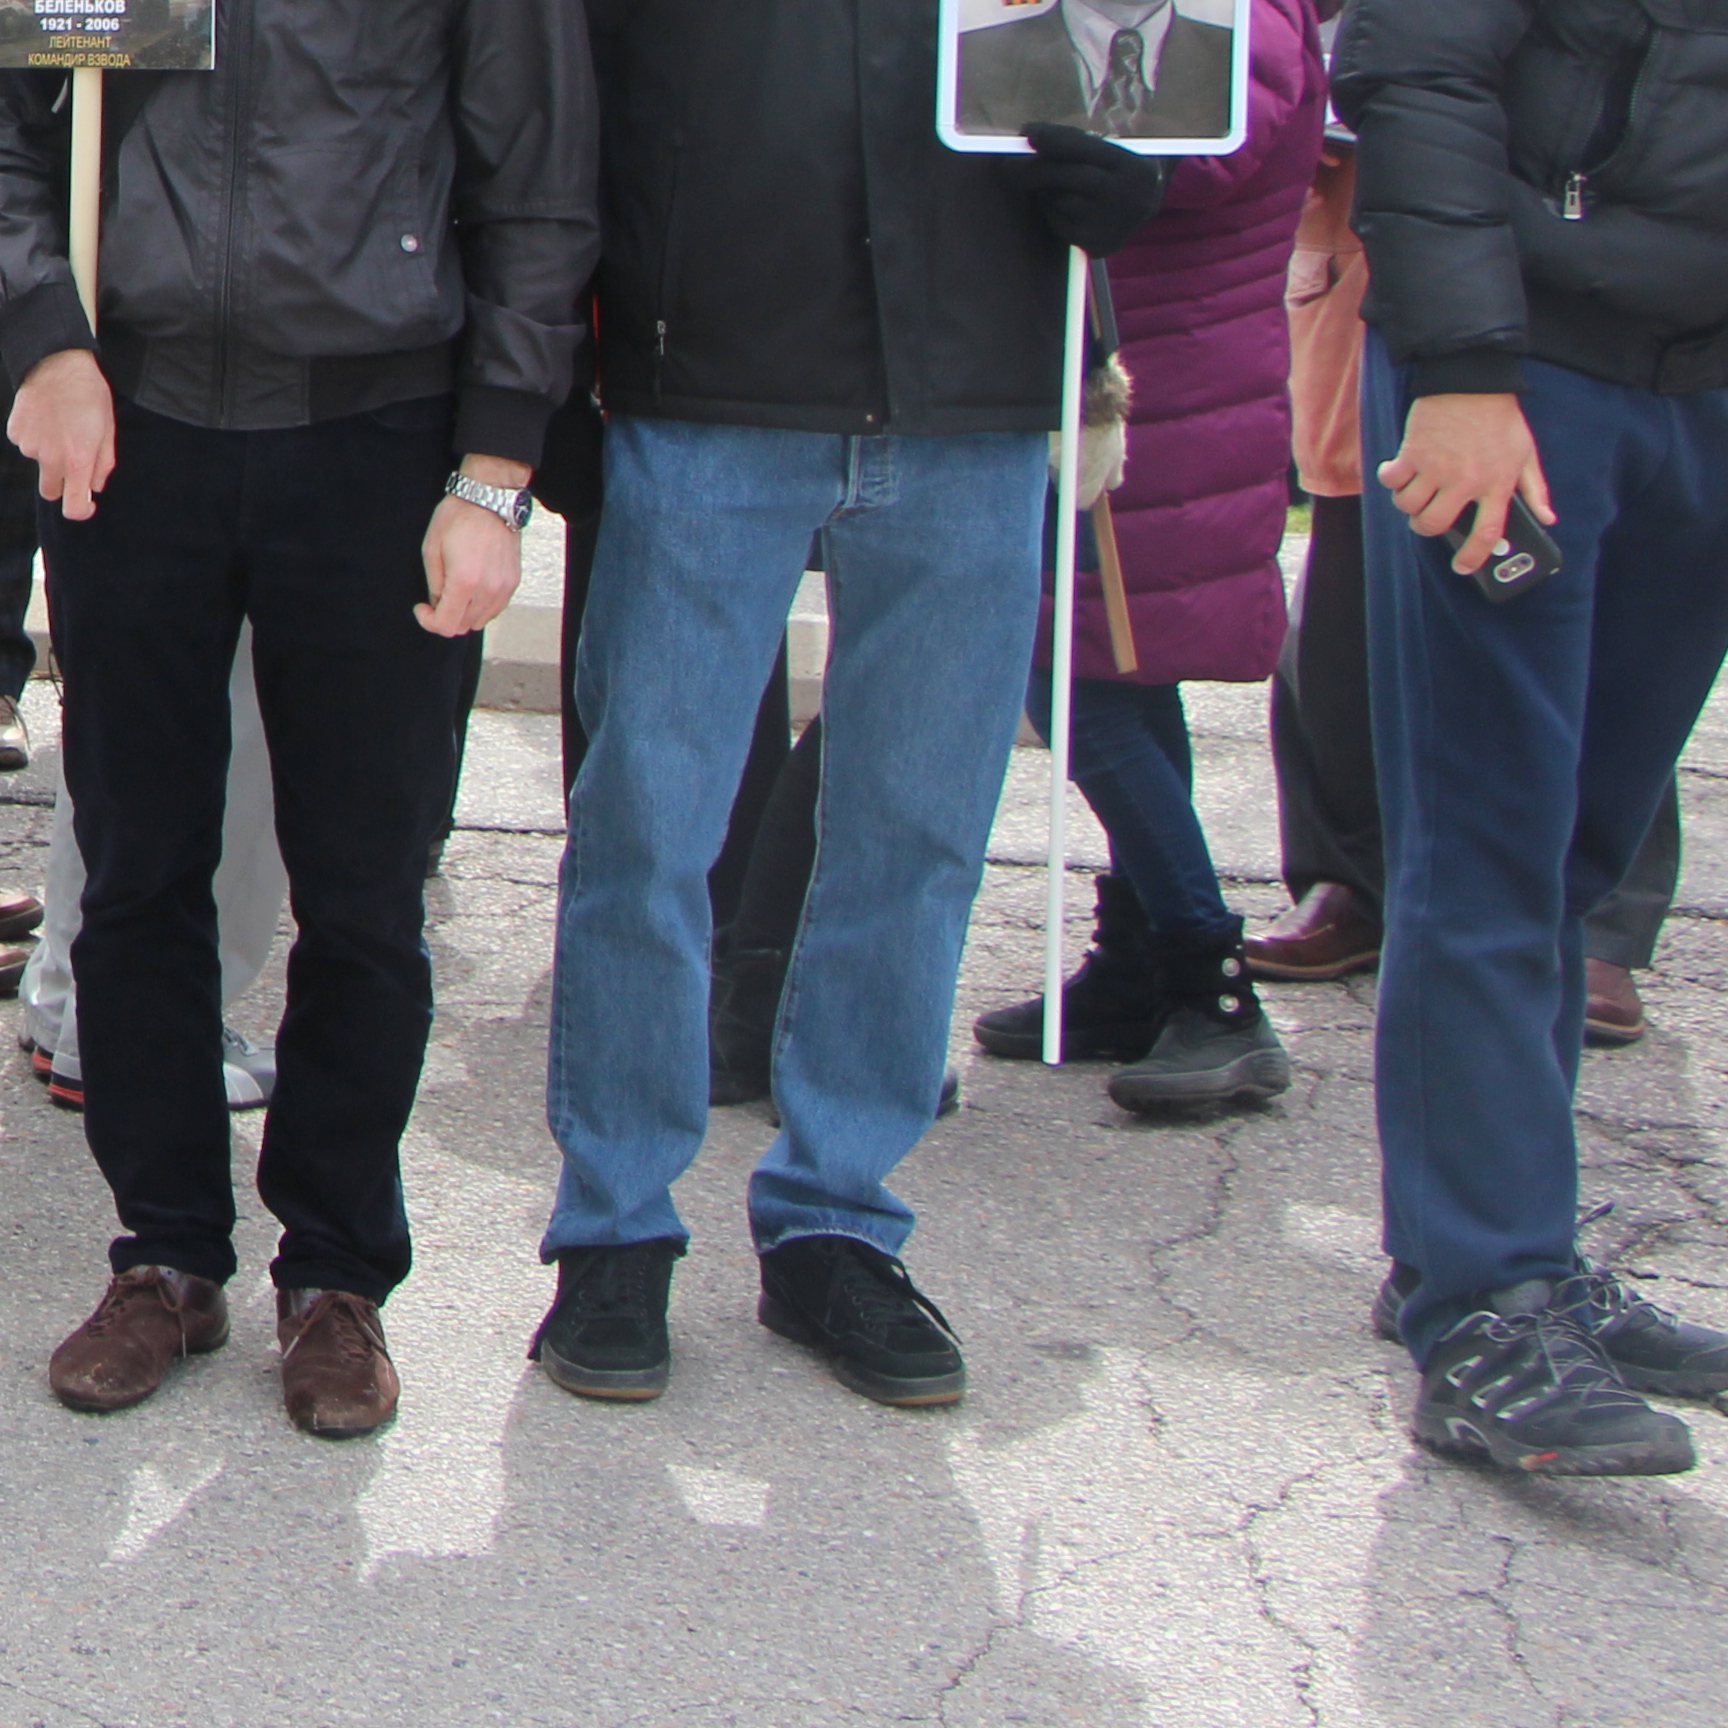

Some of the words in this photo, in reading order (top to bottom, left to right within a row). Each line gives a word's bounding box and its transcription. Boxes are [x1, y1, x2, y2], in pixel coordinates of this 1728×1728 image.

[40, 17, 72, 31] 1921
[84, 17, 120, 31] 2006
[49, 34, 112, 49] ЛЕЙТЕНАНТ
[28, 53, 86, 68] КОМАНДИР
[88, 53, 132, 68] ВЗВОДА
